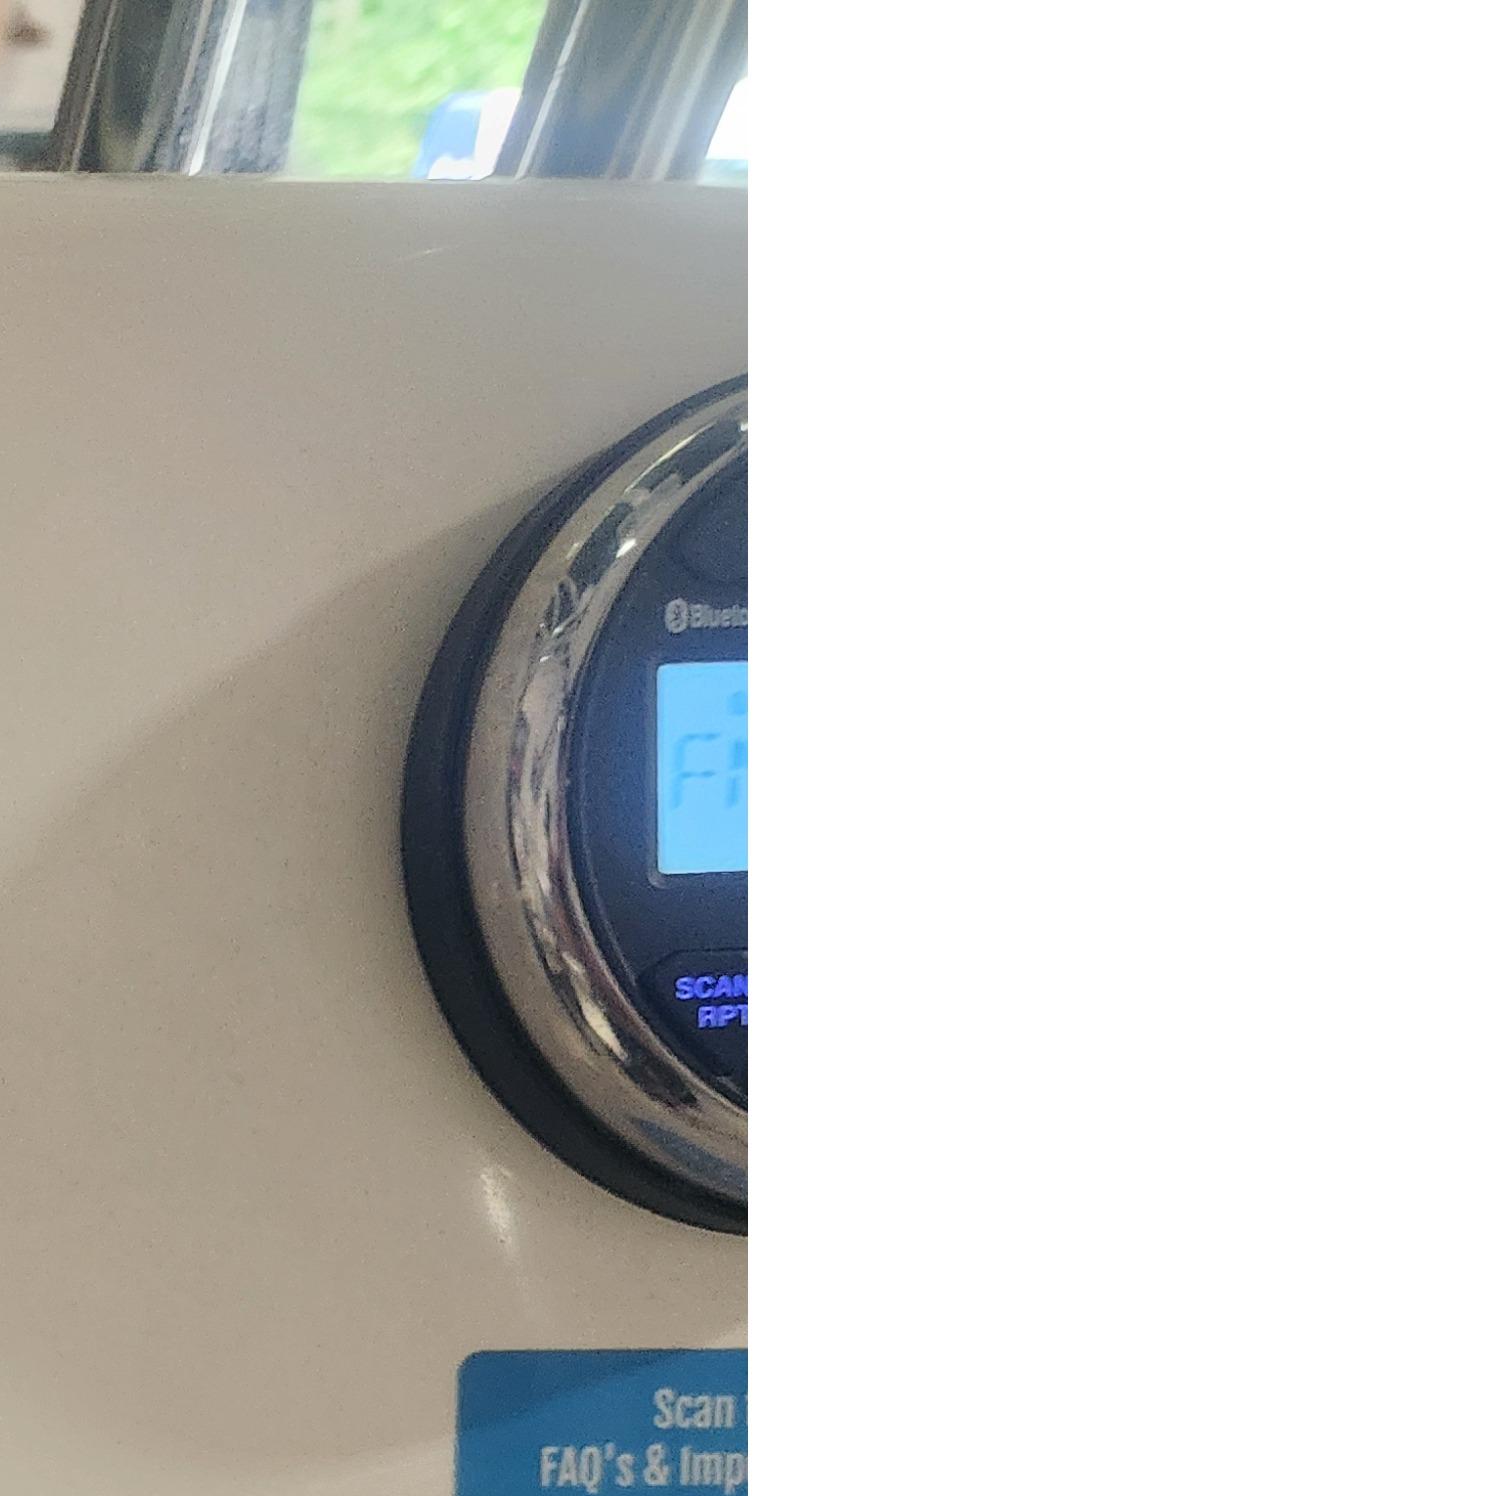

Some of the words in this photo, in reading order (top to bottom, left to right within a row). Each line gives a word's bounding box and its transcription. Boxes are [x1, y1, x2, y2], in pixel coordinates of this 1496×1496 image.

[652, 1387, 736, 1430] Scan
[539, 1443, 635, 1495] FAQ's
[644, 1443, 670, 1487] &
[680, 1445, 748, 1496] Imp
